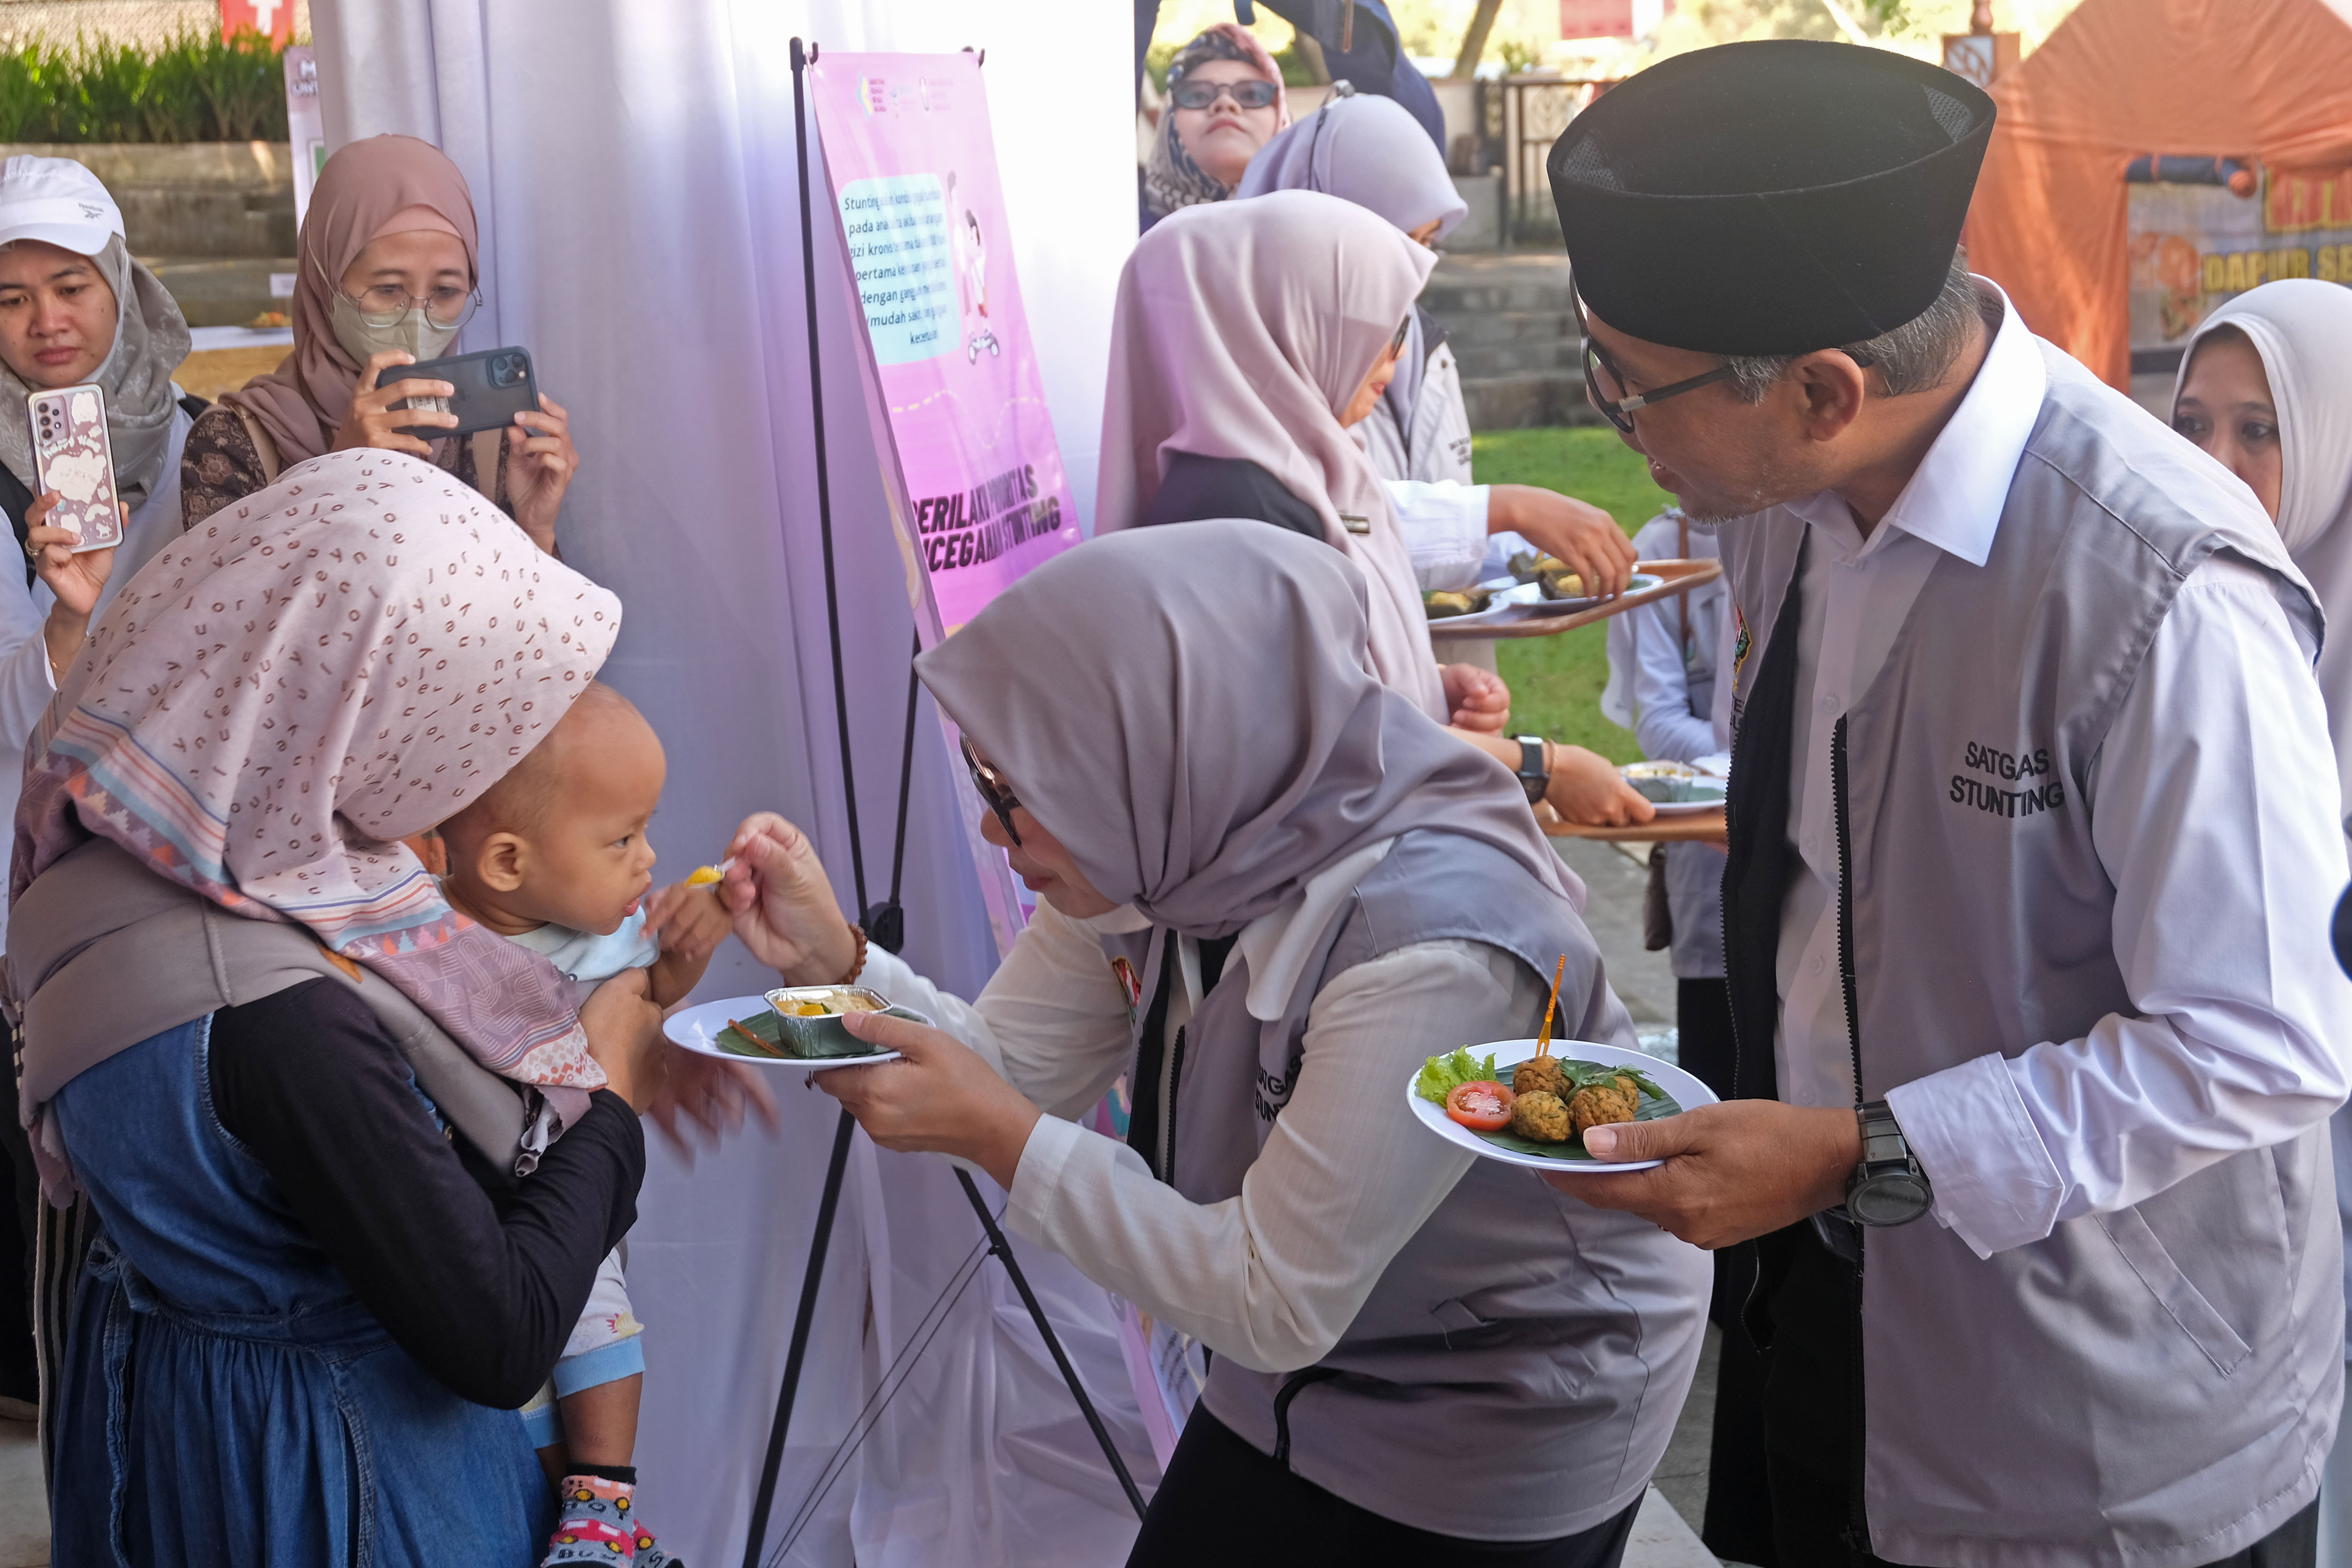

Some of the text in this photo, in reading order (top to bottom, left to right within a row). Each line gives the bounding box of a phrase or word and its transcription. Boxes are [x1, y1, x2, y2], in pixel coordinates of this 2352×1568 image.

[849, 219, 874, 238] pada
[1965, 741, 2050, 780] SATGAS
[1950, 775, 2065, 818] STUNTING
